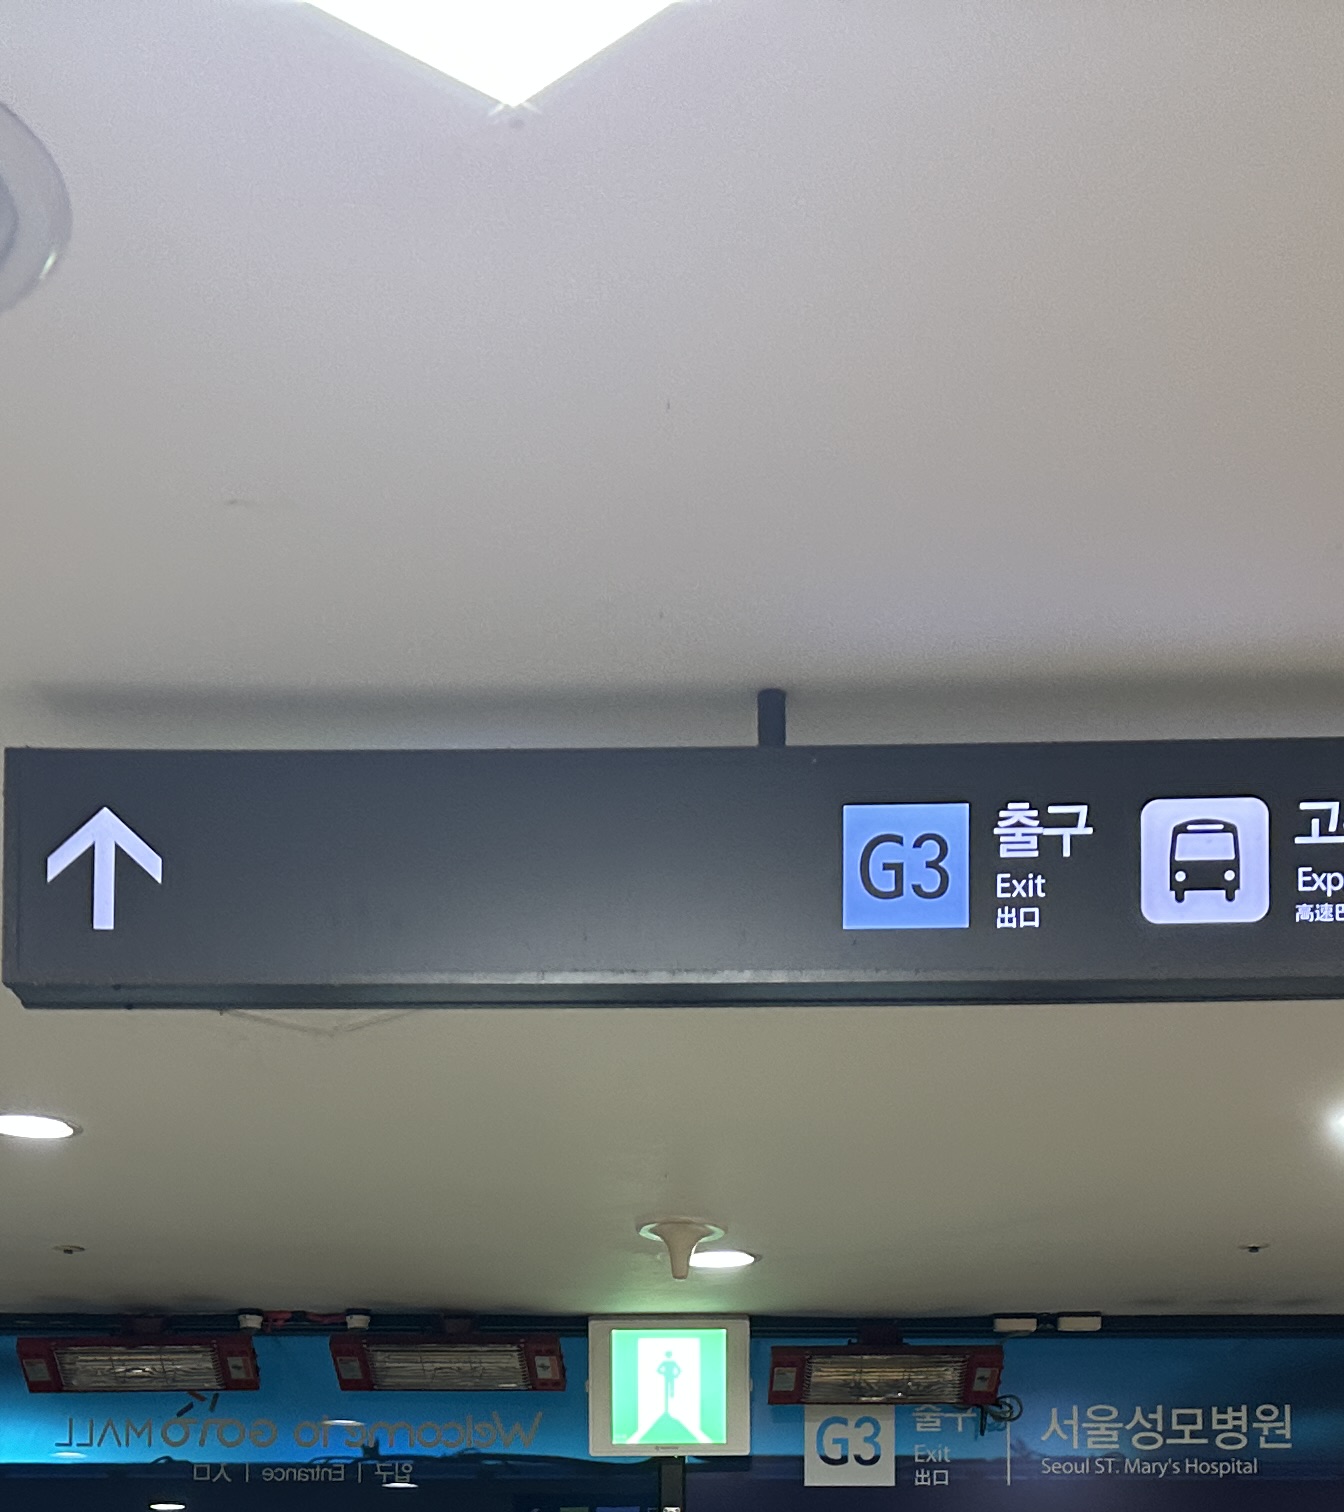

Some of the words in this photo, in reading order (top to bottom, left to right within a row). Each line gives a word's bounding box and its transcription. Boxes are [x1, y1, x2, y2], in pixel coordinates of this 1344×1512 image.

[993, 802, 1094, 859] 출구
[859, 833, 950, 900] G3
[995, 873, 1047, 899] Exit
[995, 905, 1041, 929] 出口
[1041, 1403, 1293, 1450] 서울성모병원
[815, 1415, 882, 1467] G3
[914, 1444, 950, 1463] Exit
[914, 1468, 950, 1486] 出口
[1041, 1458, 1090, 1475] Seoul
[1094, 1459, 1120, 1475] ST.
[1124, 1458, 1181, 1478] Mary's
[1185, 1457, 1258, 1478] Hospital
